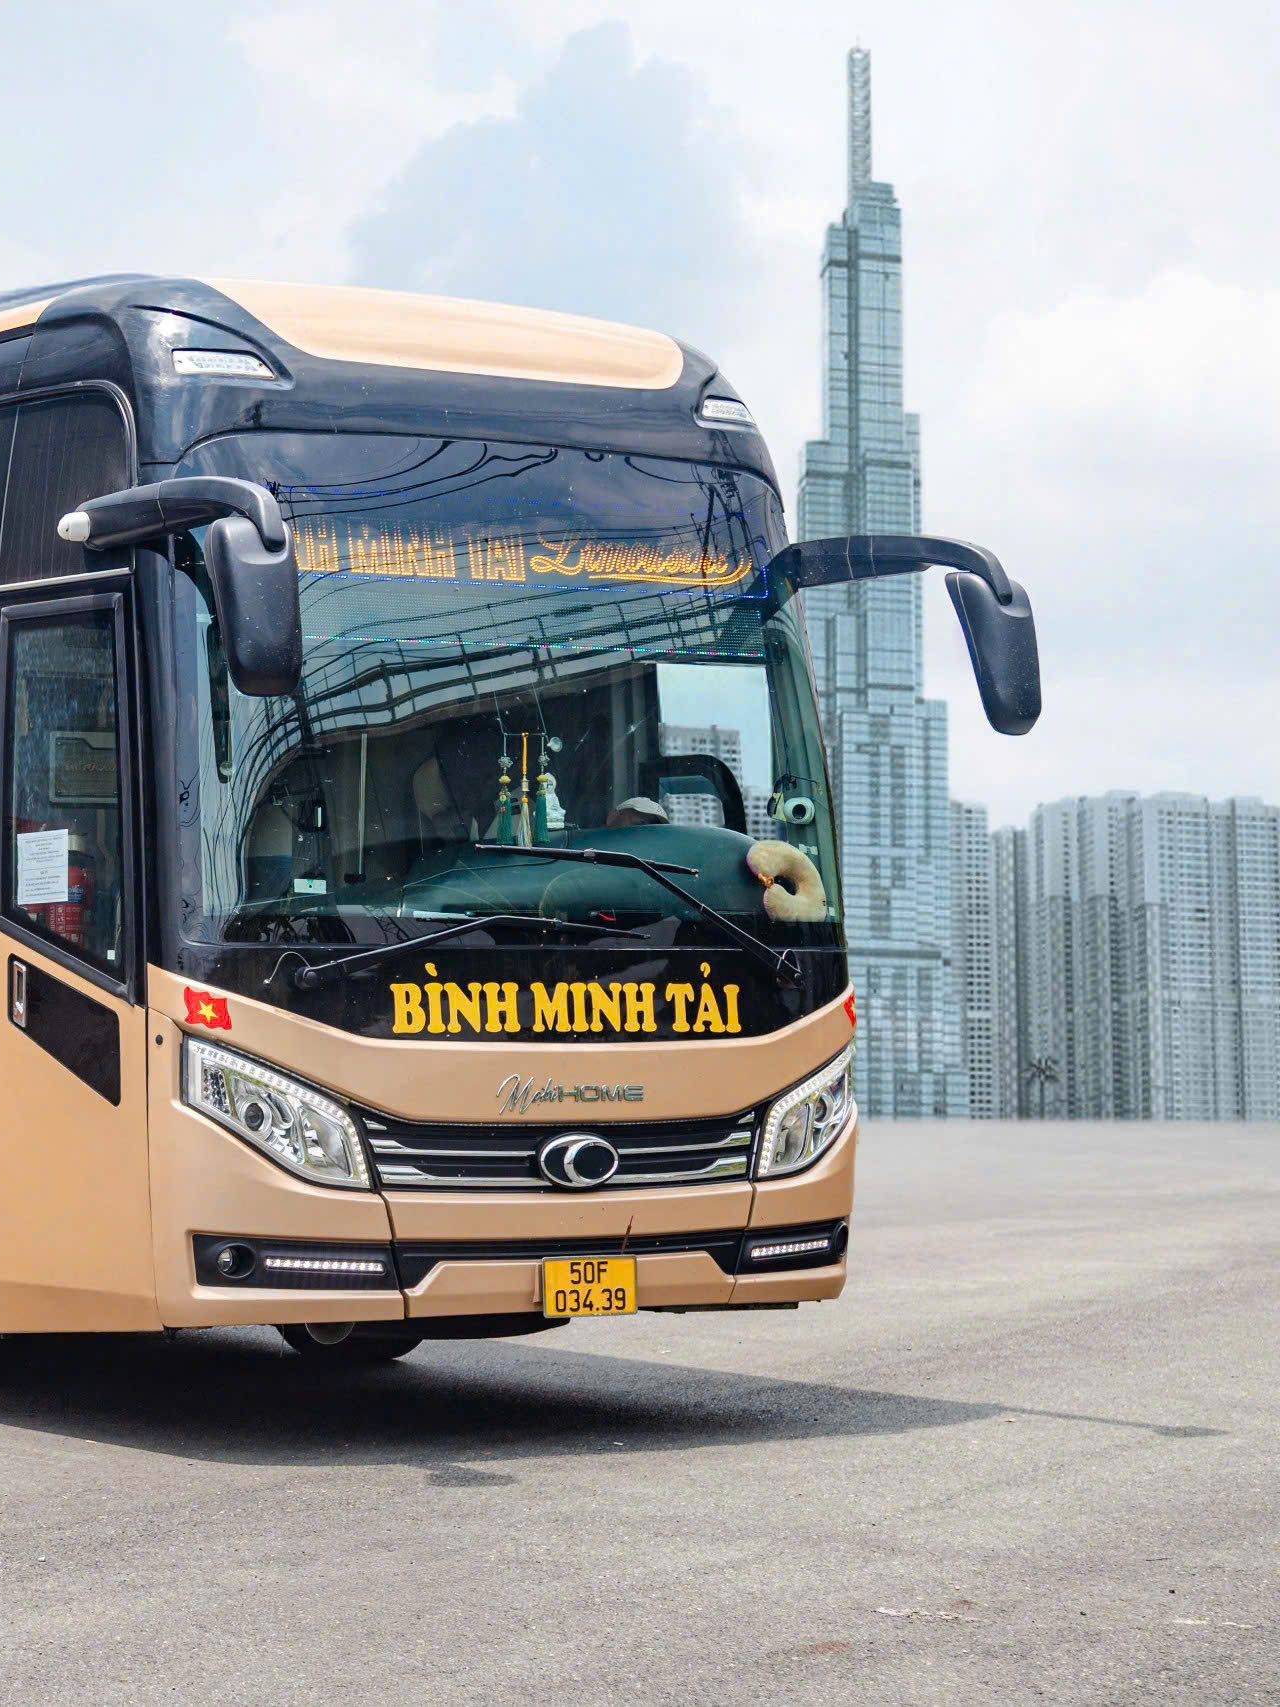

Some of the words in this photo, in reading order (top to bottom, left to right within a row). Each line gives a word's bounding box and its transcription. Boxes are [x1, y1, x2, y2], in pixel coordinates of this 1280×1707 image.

[390, 962, 521, 1034] BÌNH
[530, 982, 658, 1034] MINH
[665, 962, 743, 1034] TẢI
[569, 1260, 609, 1285] 50F
[555, 1287, 627, 1313] 034.39
